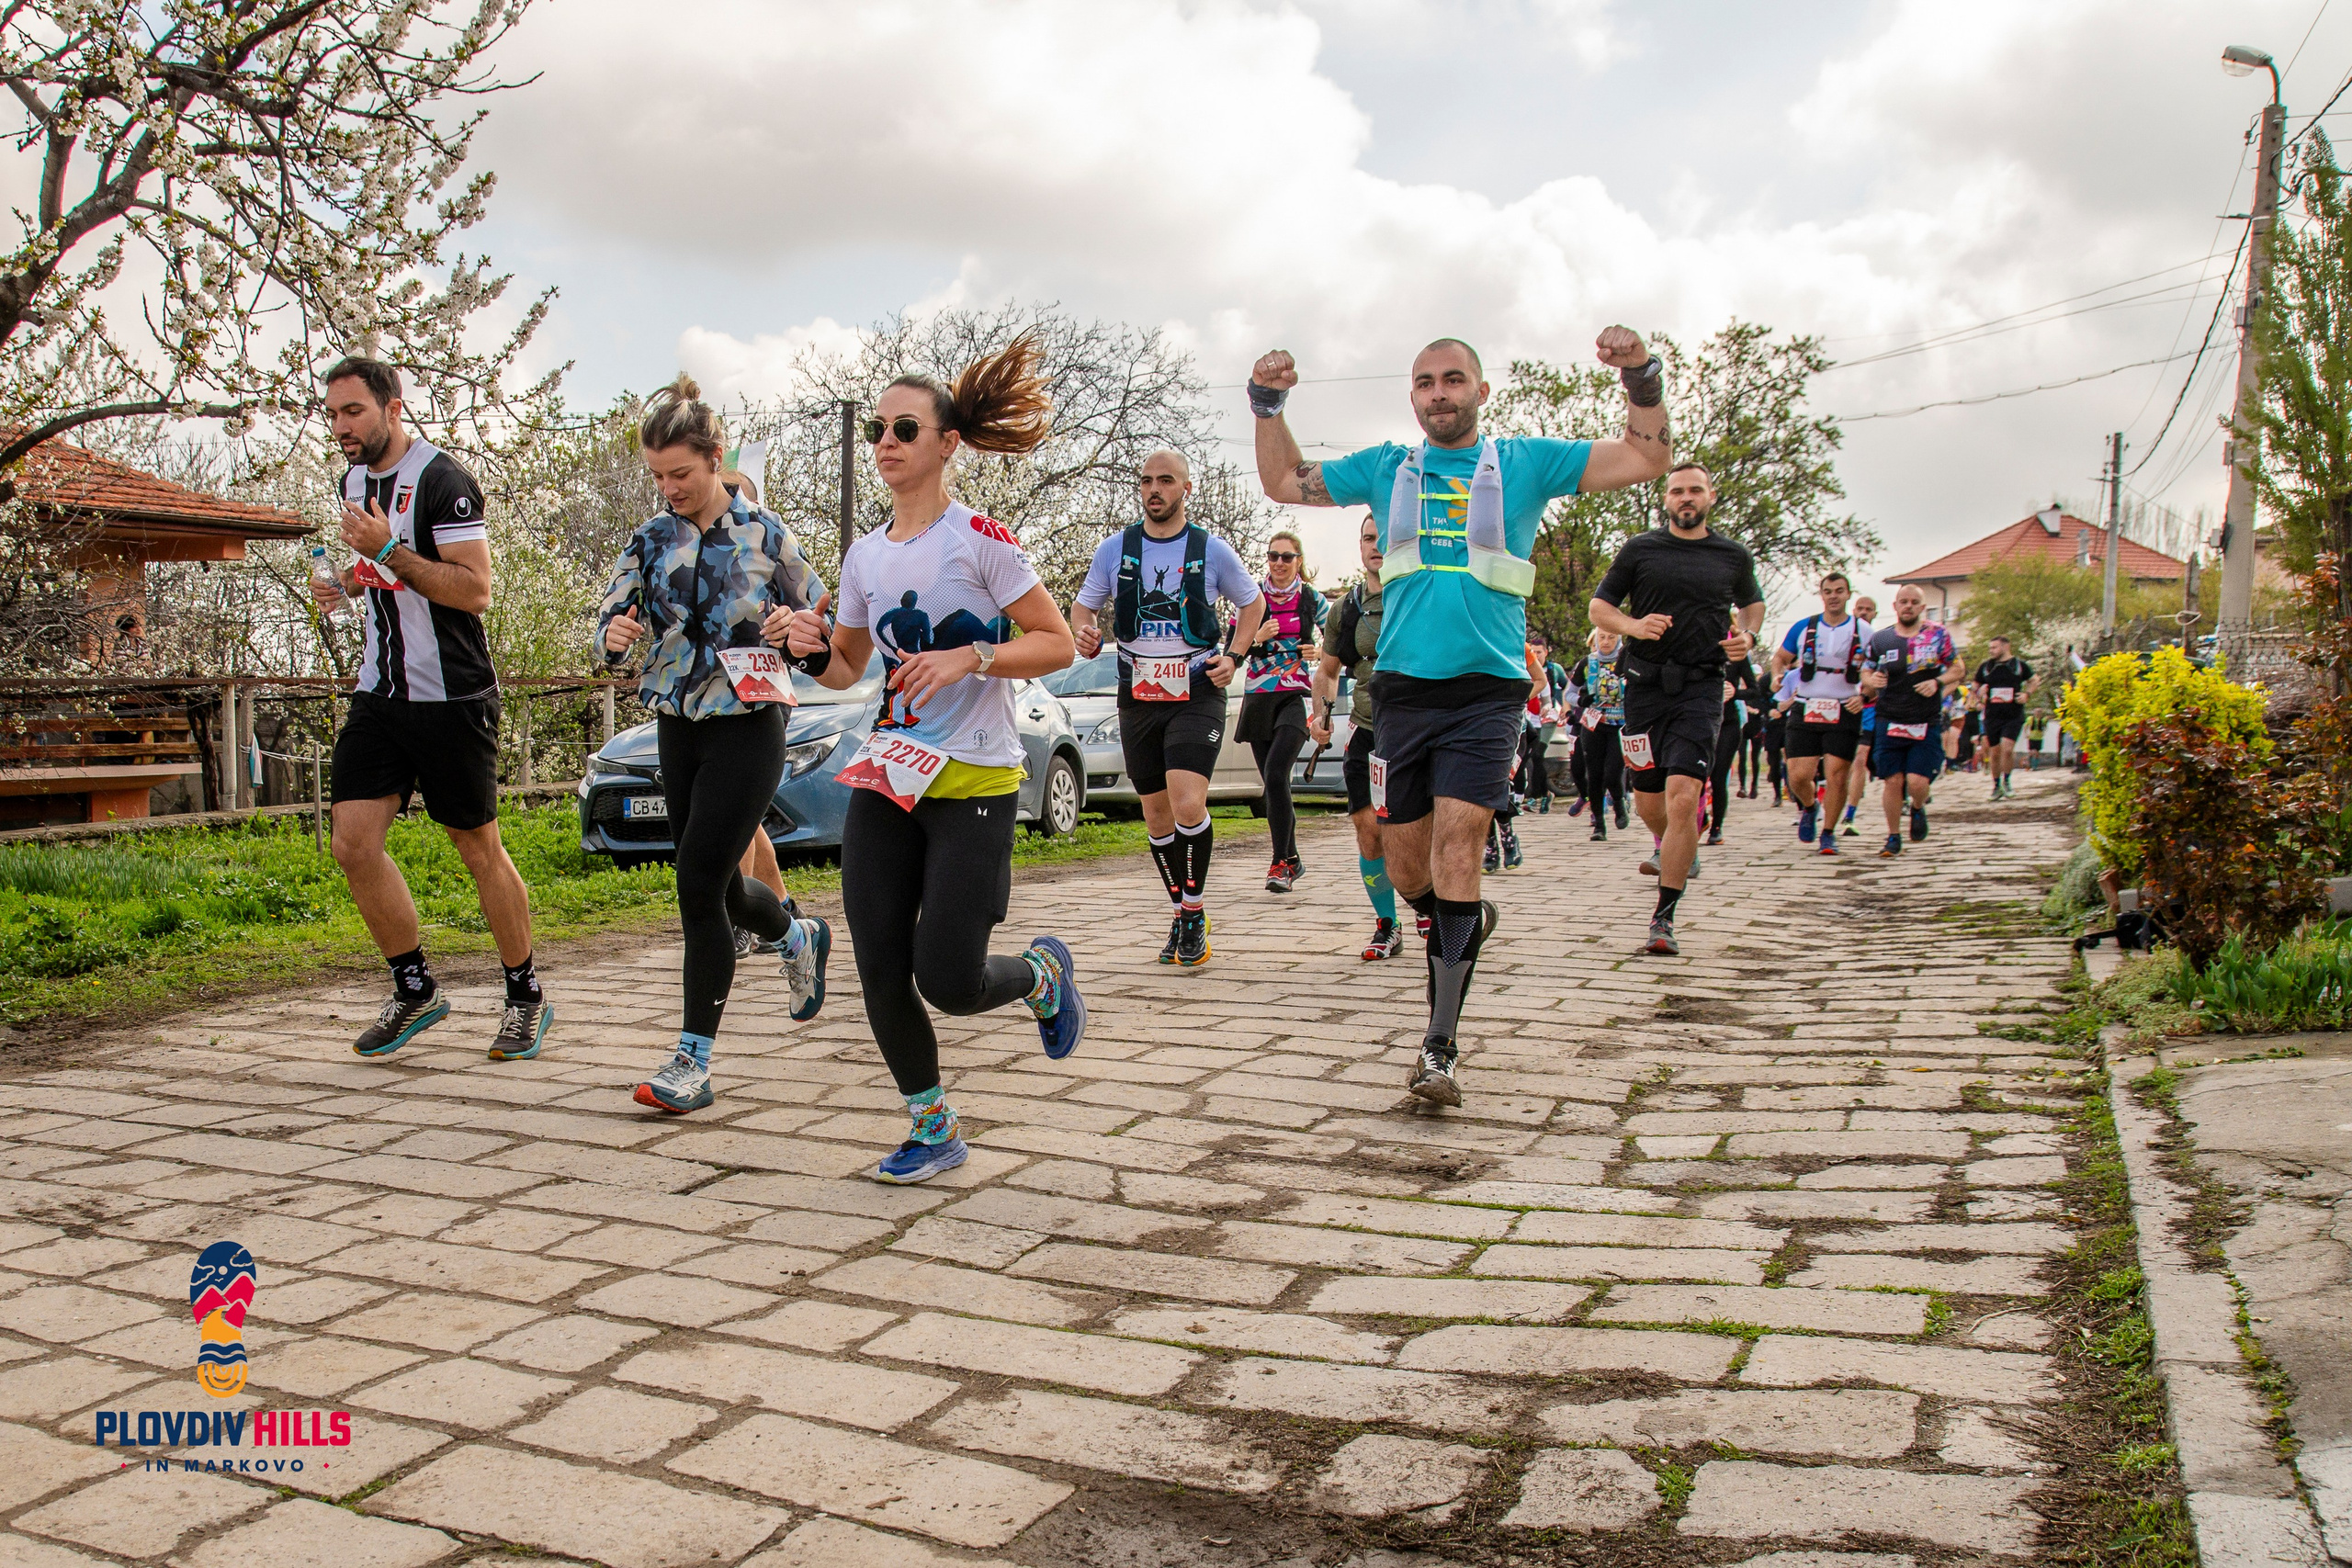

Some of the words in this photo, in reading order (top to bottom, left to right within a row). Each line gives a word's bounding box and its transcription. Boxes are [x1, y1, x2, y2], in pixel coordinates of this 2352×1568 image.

[1430, 537, 1453, 547] СЕБЕ
[748, 653, 786, 675] 2394
[1154, 662, 1186, 678] 2410
[1623, 738, 1646, 752] 2167
[880, 739, 941, 776] 2270
[633, 800, 650, 815] CB
